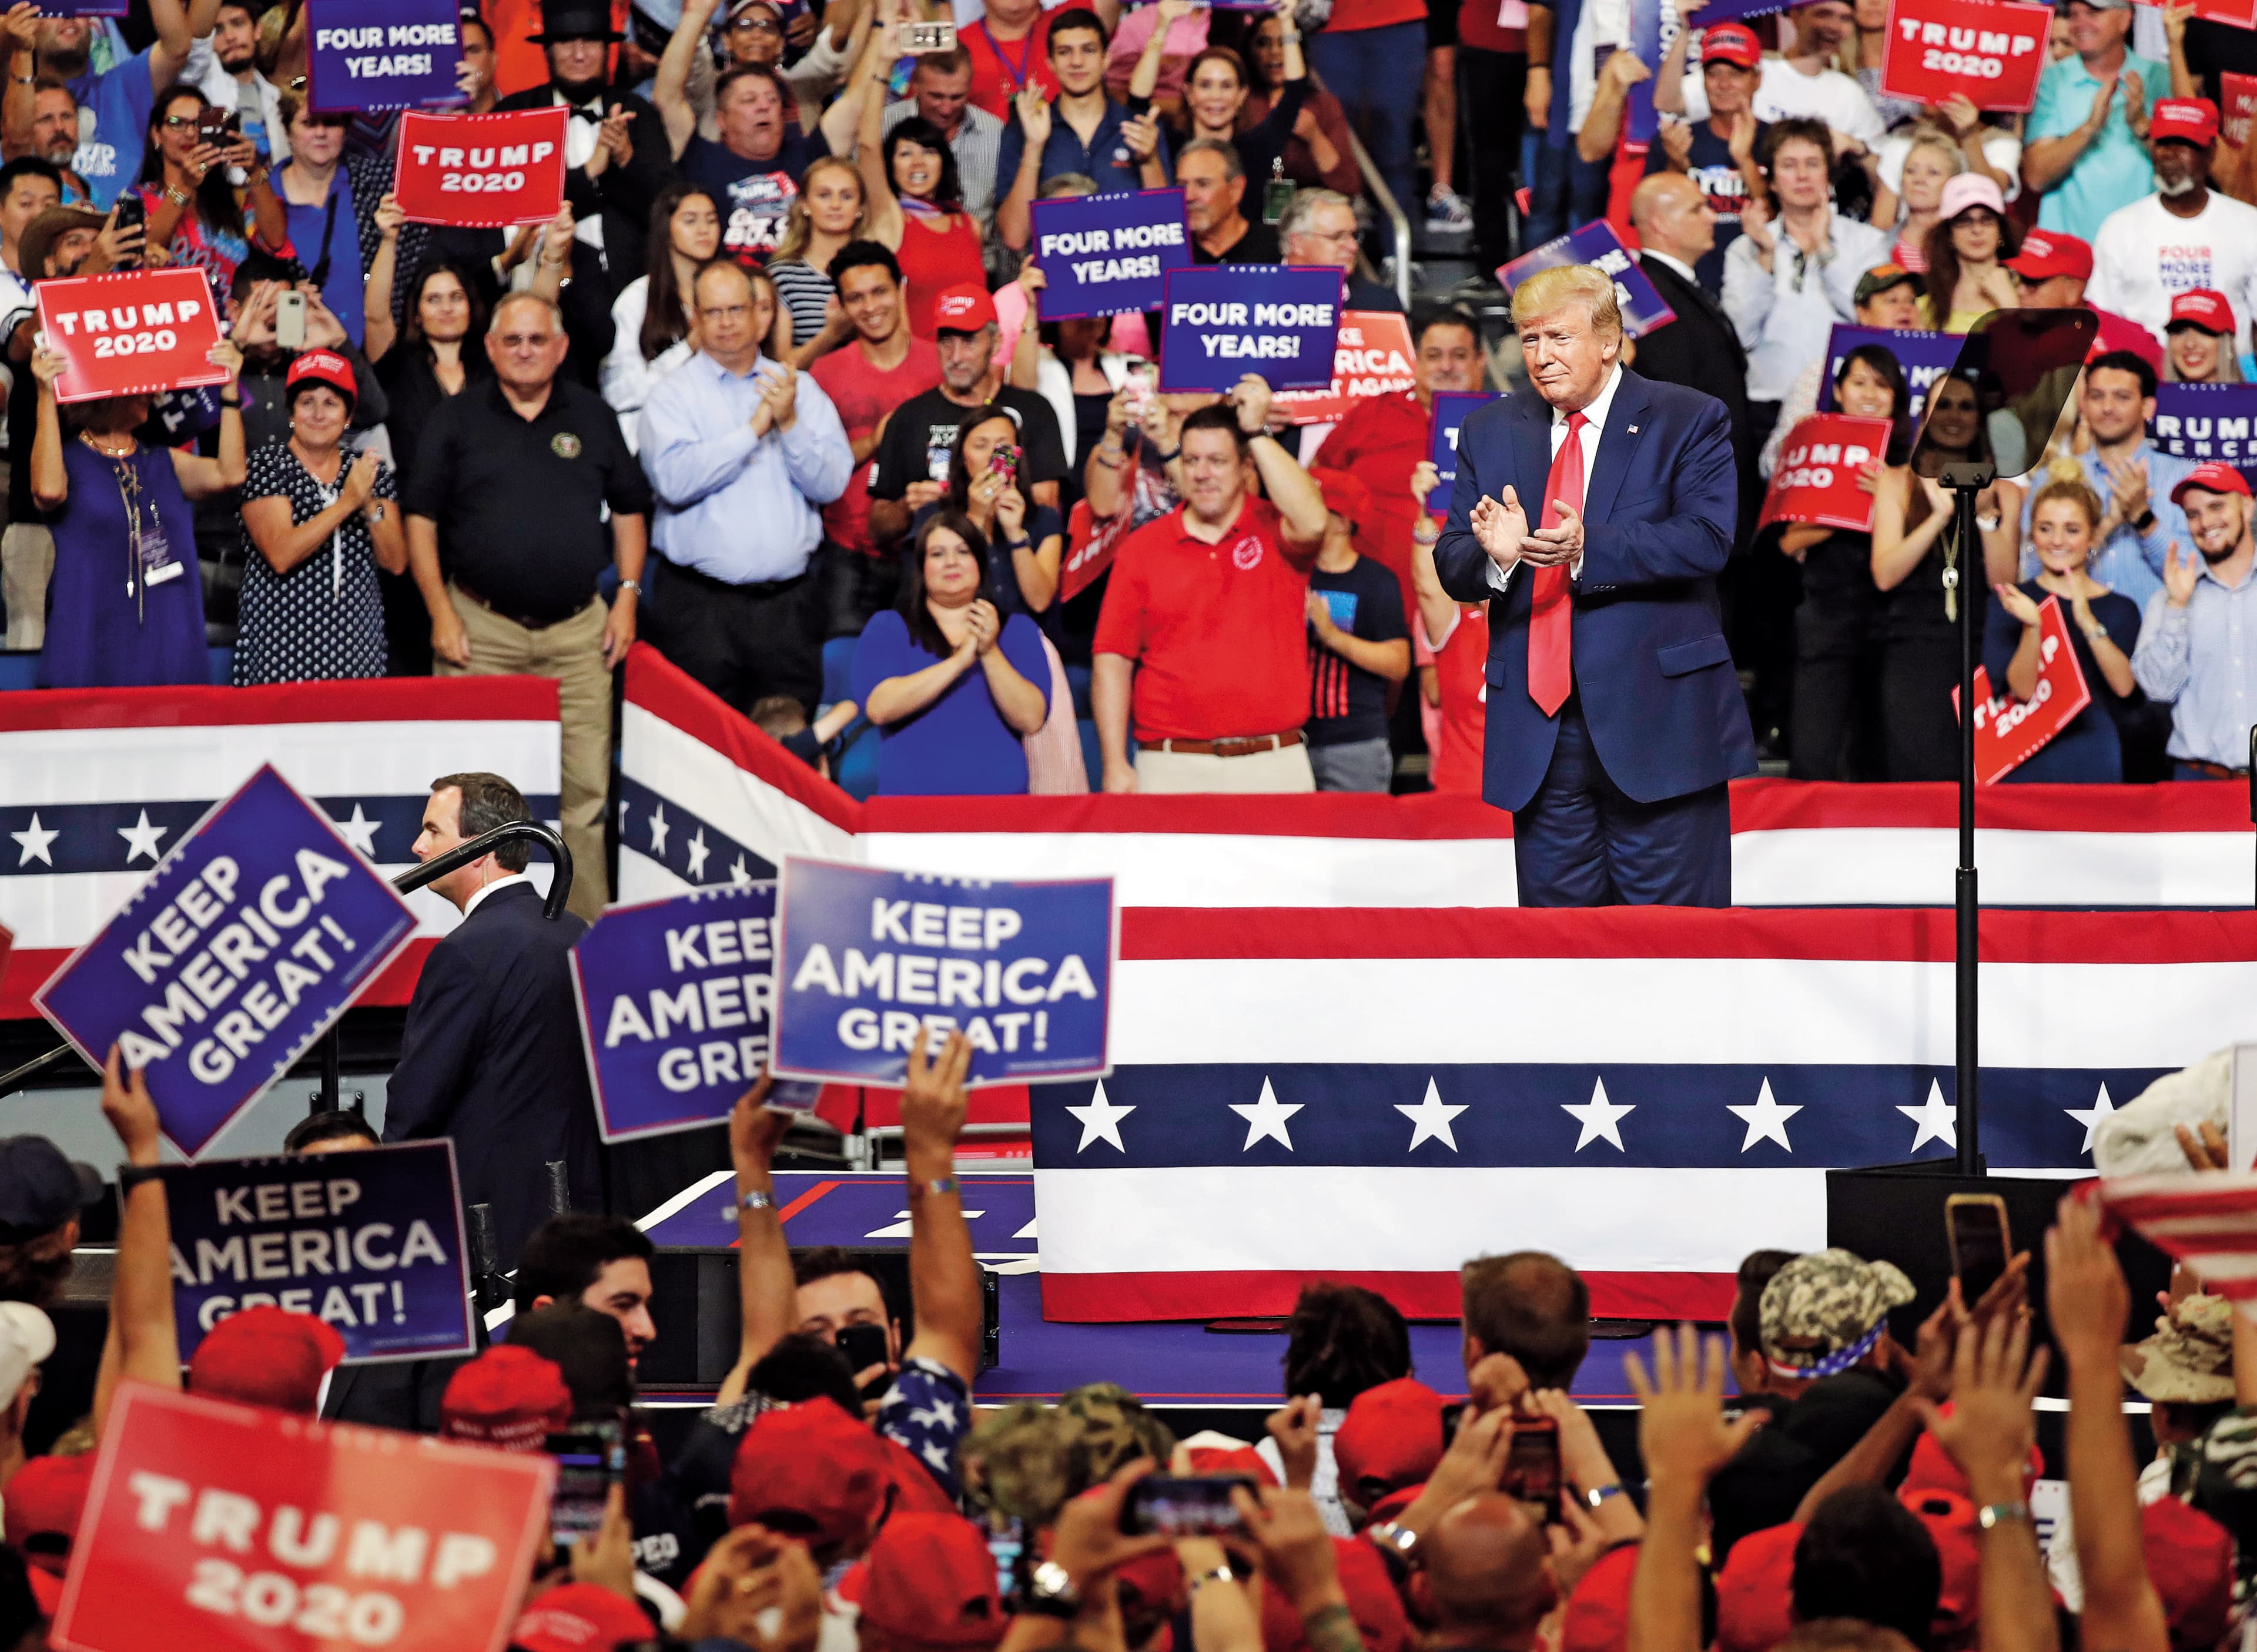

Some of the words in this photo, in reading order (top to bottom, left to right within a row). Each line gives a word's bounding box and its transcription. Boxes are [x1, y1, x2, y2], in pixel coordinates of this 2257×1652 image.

[316, 27, 384, 51] FOUR
[388, 23, 457, 47] MORE
[1898, 18, 2035, 56] TRUMP
[345, 53, 433, 78] YEARS!
[1922, 48, 2003, 78] 2020
[413, 141, 554, 168] TRUMP
[441, 172, 525, 192] 2020
[1041, 230, 1110, 257] FOUR
[1113, 222, 1185, 250] MORE
[2159, 246, 2211, 259] FOUR
[1071, 254, 1161, 284] YEARS!
[2159, 262, 2211, 273] MORE
[55, 300, 200, 335] TRUMP
[1171, 303, 1248, 326] FOUR
[1254, 303, 1334, 327] MORE
[94, 330, 176, 358] 2020
[1201, 334, 1301, 358] YEARS!
[1334, 349, 1413, 375] RICA
[2156, 415, 2257, 440] RUM
[1787, 443, 1870, 468] UMP
[1777, 467, 1834, 489] 020
[122, 855, 240, 984] KEEP
[872, 897, 1023, 950] KEEP
[118, 848, 350, 1070] AMERICA
[665, 917, 779, 973] KEE
[792, 943, 1097, 1008] AMERICA
[187, 915, 356, 1084] GREAT!
[604, 973, 772, 1048] AMER
[657, 1035, 769, 1093] GRE
[215, 1178, 361, 1225] KEEP
[171, 1219, 448, 1286] AMERICA
[129, 1470, 497, 1588] TRUMP
[185, 1557, 405, 1646] 2020
